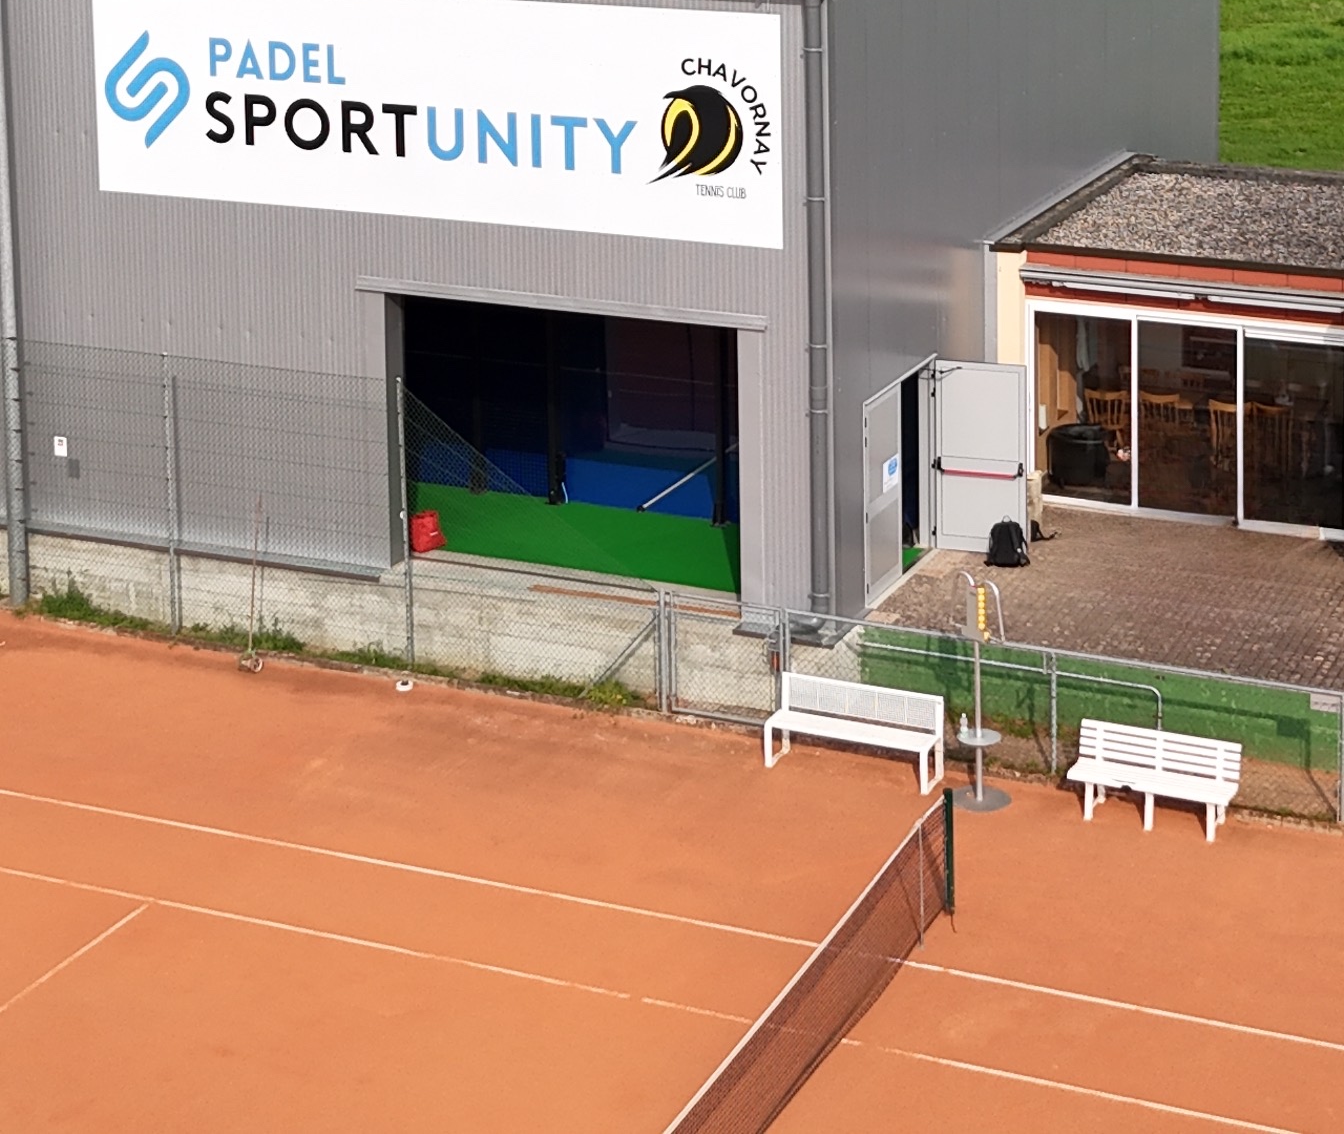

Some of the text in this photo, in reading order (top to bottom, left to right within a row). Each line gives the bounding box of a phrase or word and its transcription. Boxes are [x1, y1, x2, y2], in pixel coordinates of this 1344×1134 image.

[208, 37, 346, 86] PADEL
[205, 90, 638, 175] SPORTUNITY
[680, 57, 772, 176] CHAVORNAY
[695, 183, 747, 200] TENNIS CLUB
